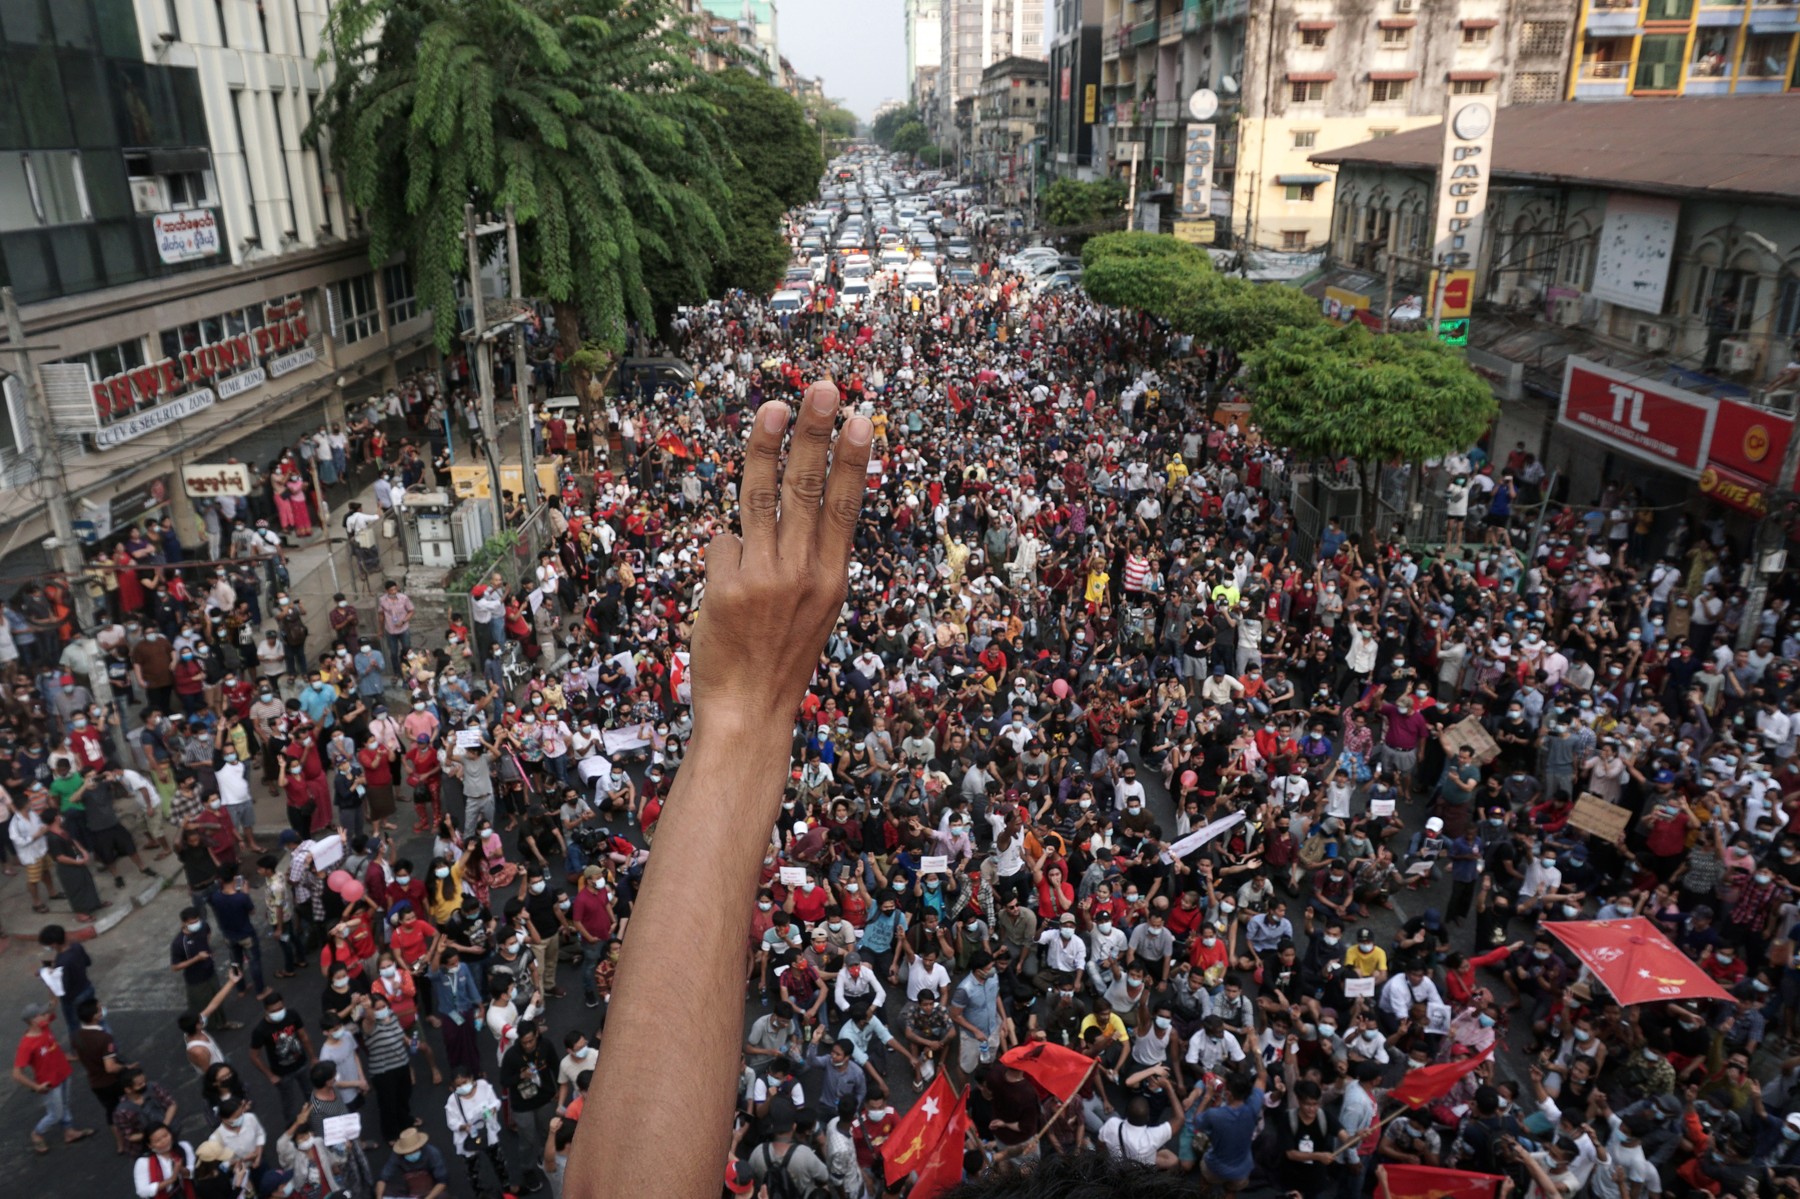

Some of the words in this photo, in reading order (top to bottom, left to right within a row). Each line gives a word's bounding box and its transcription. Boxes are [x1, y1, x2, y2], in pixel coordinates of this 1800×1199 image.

[1184, 128, 1212, 214] PACIFIC
[1444, 146, 1482, 267] PACIFIC
[93, 359, 181, 417] SHWE
[179, 333, 251, 383] LUNN
[253, 313, 309, 357] PYAN
[299, 350, 315, 363] ZONE
[220, 382, 241, 397] TIME
[244, 370, 262, 387] ZONE
[1609, 383, 1649, 432] TL
[97, 424, 128, 446] CCTV
[129, 420, 138, 434] &
[140, 402, 186, 431] SECURITY
[189, 391, 212, 411] ZONE
[1717, 482, 1749, 502] FIVE
